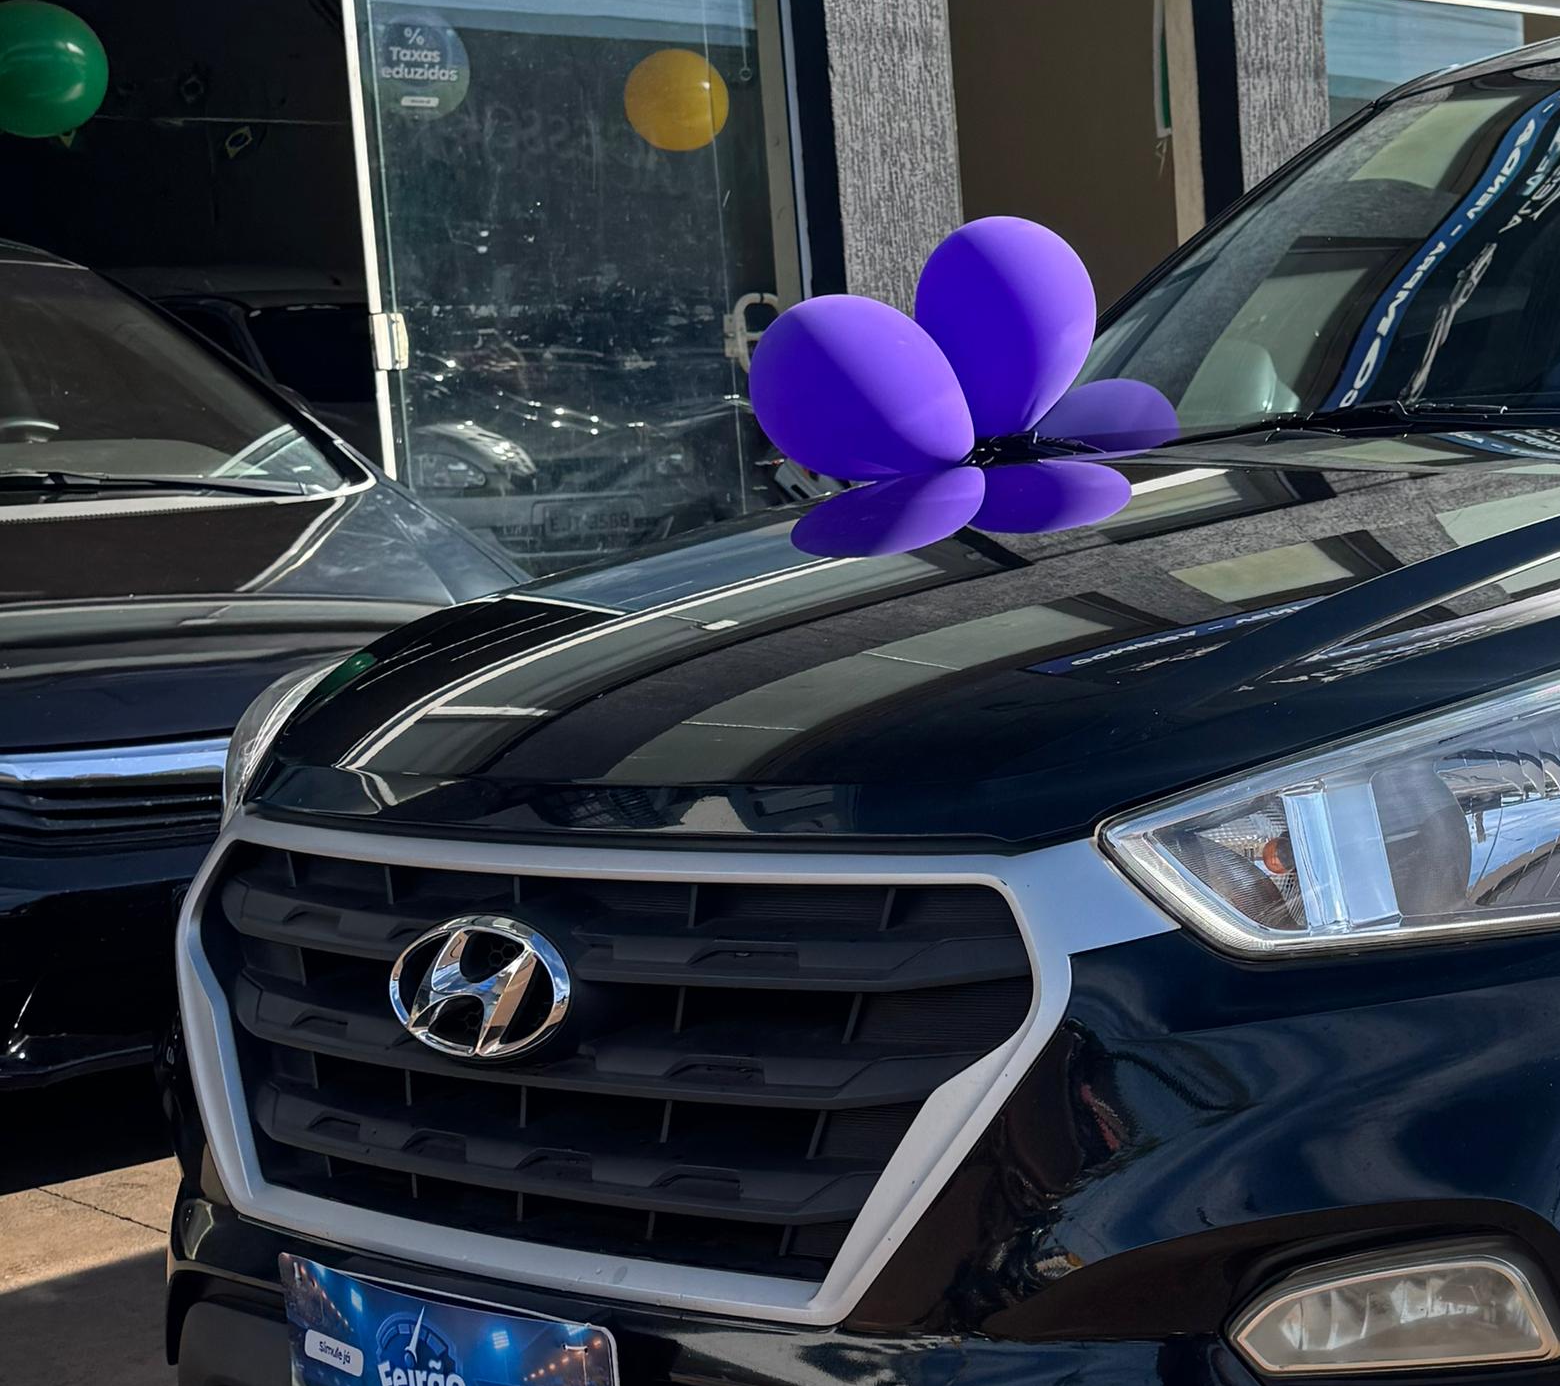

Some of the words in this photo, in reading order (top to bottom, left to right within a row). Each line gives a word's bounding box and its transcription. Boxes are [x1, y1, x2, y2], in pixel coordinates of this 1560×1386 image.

[404, 28, 425, 45] %
[389, 47, 441, 63] Taxas
[381, 64, 458, 81] eduzidas
